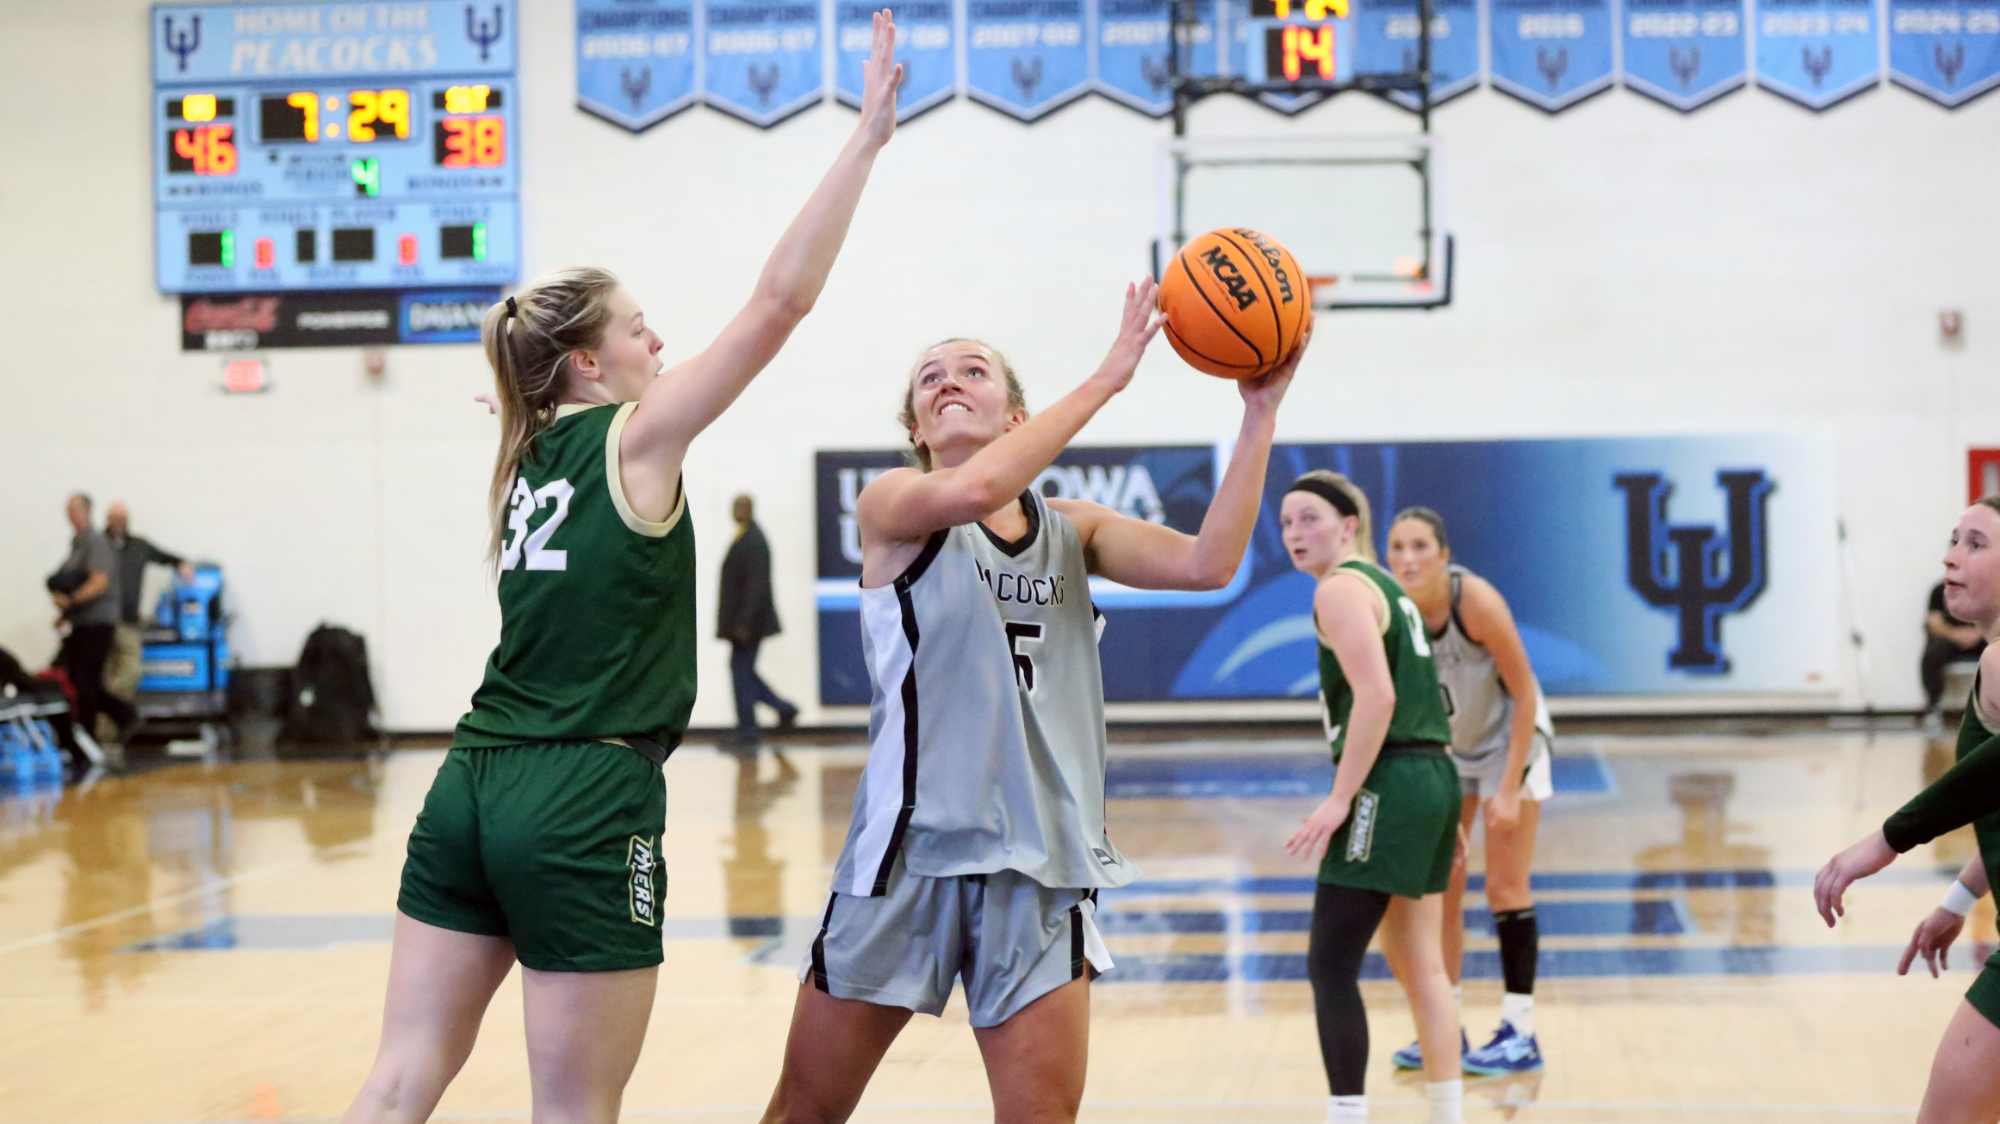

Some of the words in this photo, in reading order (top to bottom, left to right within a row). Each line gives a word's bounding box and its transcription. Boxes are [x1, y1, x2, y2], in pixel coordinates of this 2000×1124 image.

[234, 8, 320, 34] HOME
[330, 5, 367, 32] OF
[376, 4, 429, 30] THE
[229, 33, 440, 76] PEACOCKS
[1282, 24, 1336, 80] 14
[287, 88, 411, 143] 7:29
[443, 115, 506, 169] 38
[174, 123, 238, 176] 46
[352, 157, 380, 197] 4
[1200, 246, 1260, 312] NCAA
[1233, 227, 1294, 306] Wilson
[1030, 465, 1164, 510] OWA
[500, 476, 575, 571] 32
[632, 842, 653, 918] MERS
